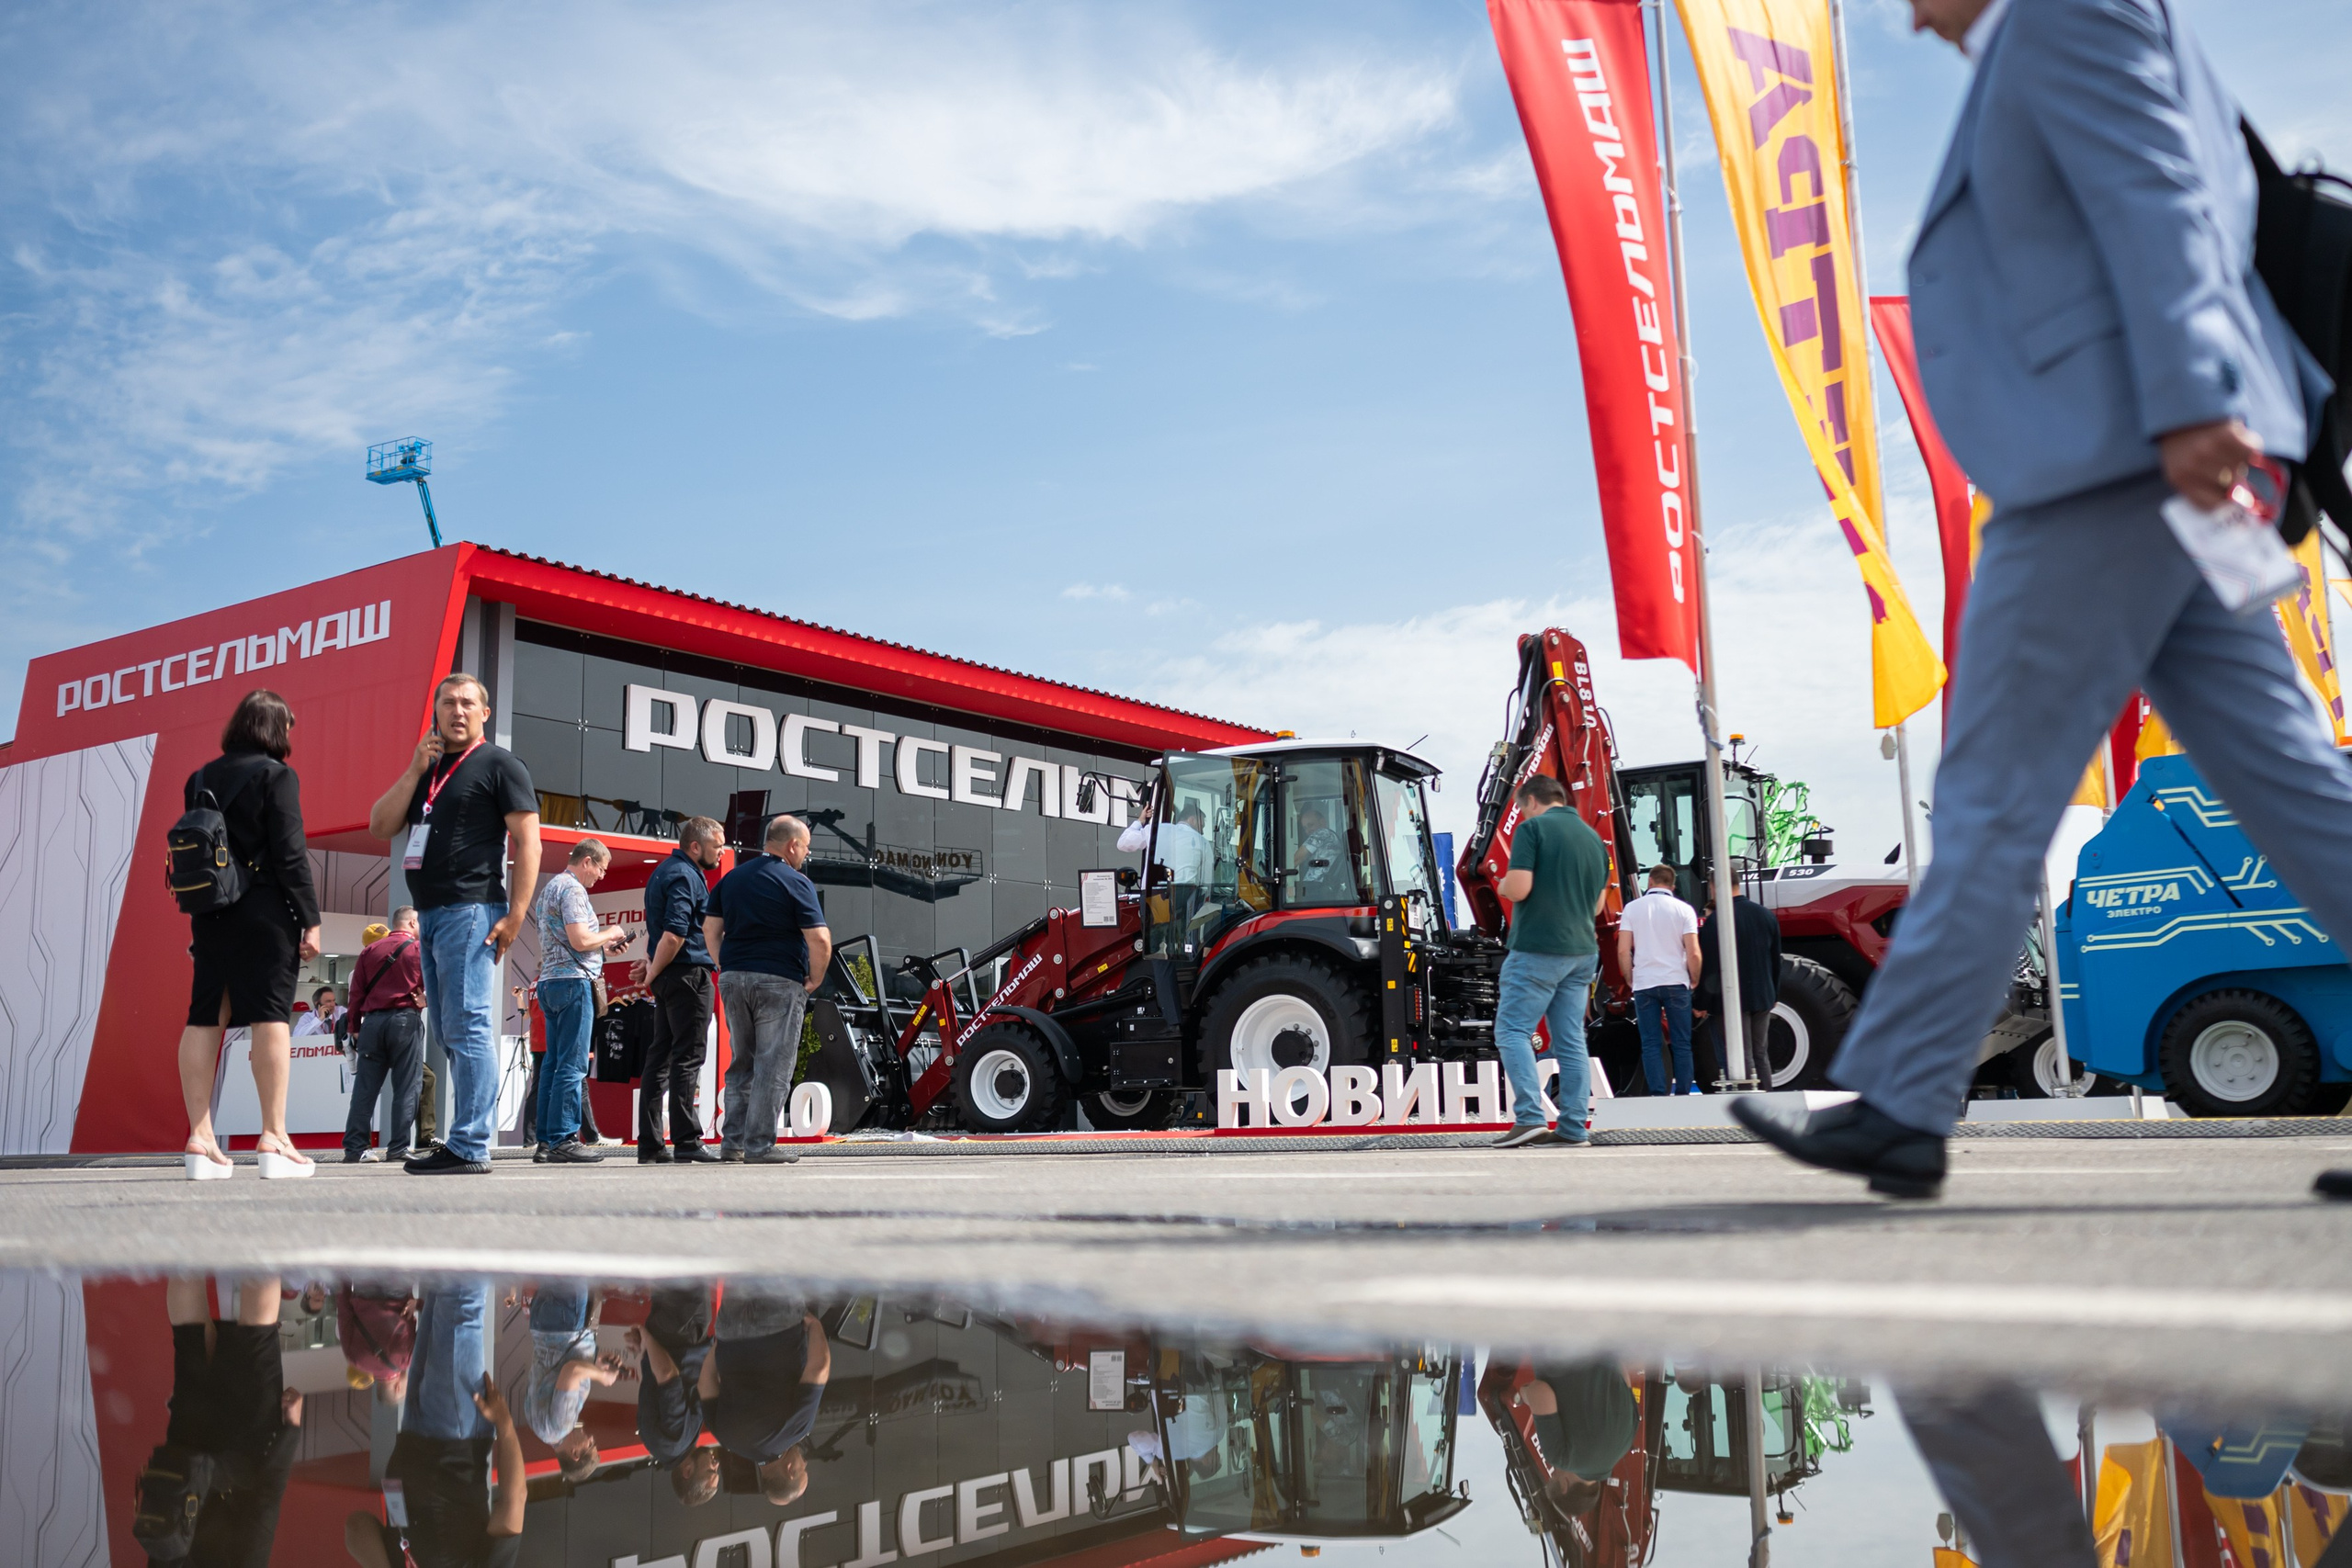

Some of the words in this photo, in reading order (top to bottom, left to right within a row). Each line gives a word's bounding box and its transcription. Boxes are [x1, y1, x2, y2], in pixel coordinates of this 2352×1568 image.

[1561, 37, 1686, 604] РОСТСЕЛЬМАШ
[56, 599, 391, 717] РОСТСЕЛЬМАШ
[1574, 660, 1598, 728] BL810
[624, 683, 1154, 828] РОСТСЕЛЬМ
[1789, 868, 1815, 876] 530
[2086, 882, 2181, 908] ЧЕТРА
[2107, 906, 2162, 919] ЭЛЕКТРО
